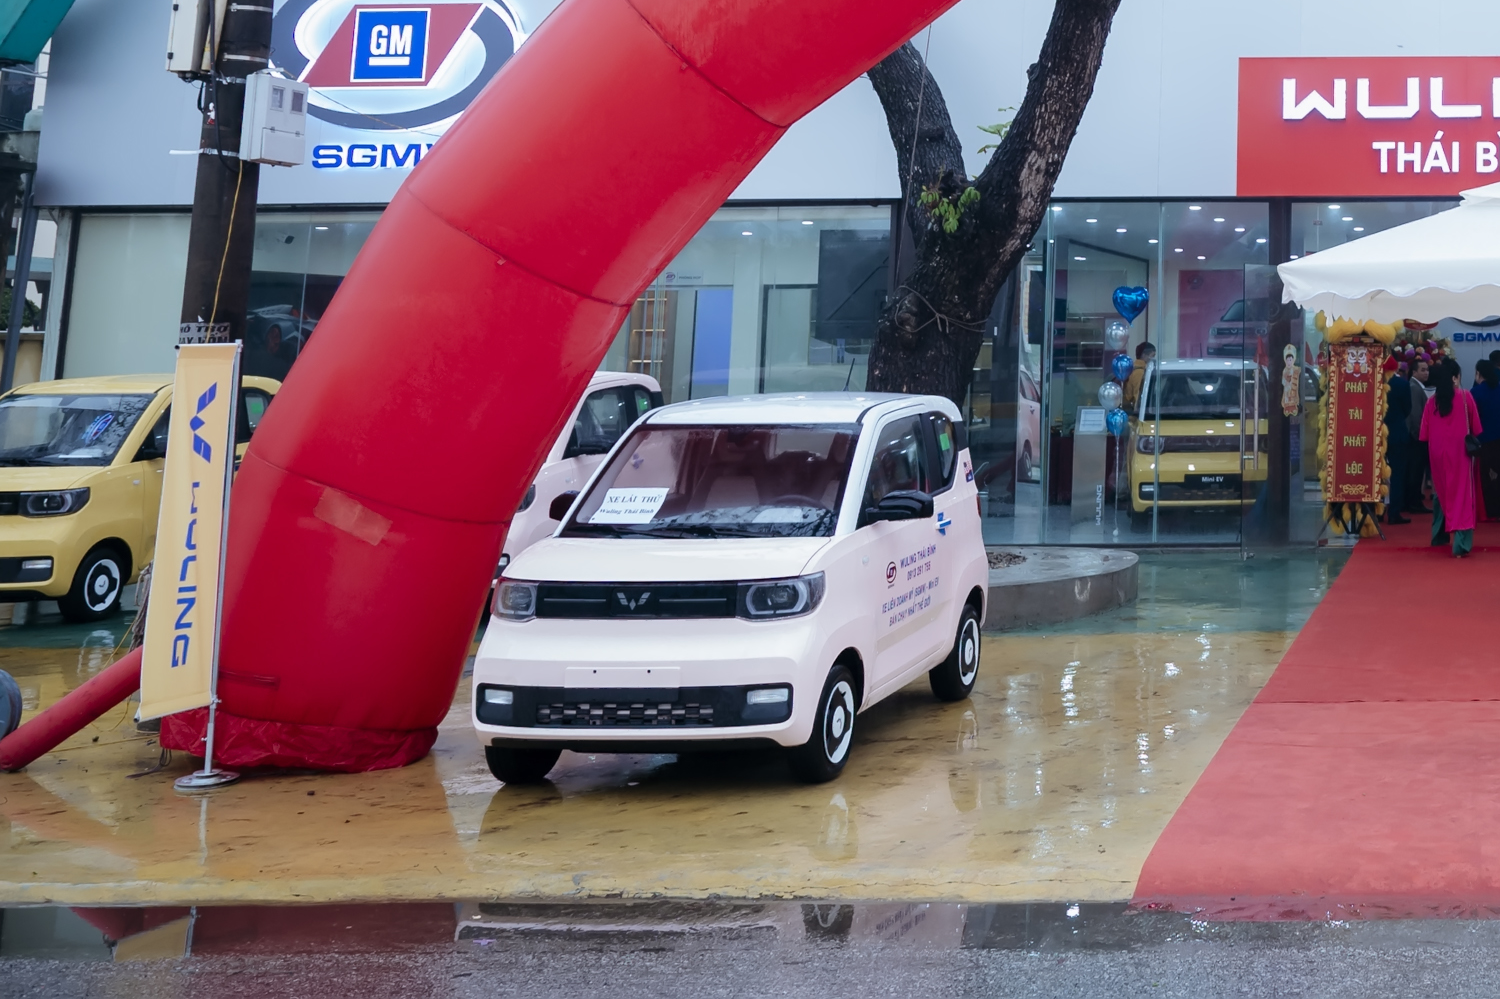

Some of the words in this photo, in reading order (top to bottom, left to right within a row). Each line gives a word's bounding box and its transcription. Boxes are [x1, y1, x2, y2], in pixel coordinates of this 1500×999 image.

[369, 24, 413, 56] GM
[311, 143, 438, 169] SGM
[1372, 130, 1460, 174] THÁI
[1344, 381, 1368, 393] PHÁT
[1348, 407, 1363, 420] TÀI
[1343, 435, 1367, 447] PHÁT
[1345, 461, 1363, 477] LỘC
[621, 494, 638, 503] LÁI
[1095, 484, 1103, 526] WULING
[900, 552, 917, 569] WULING
